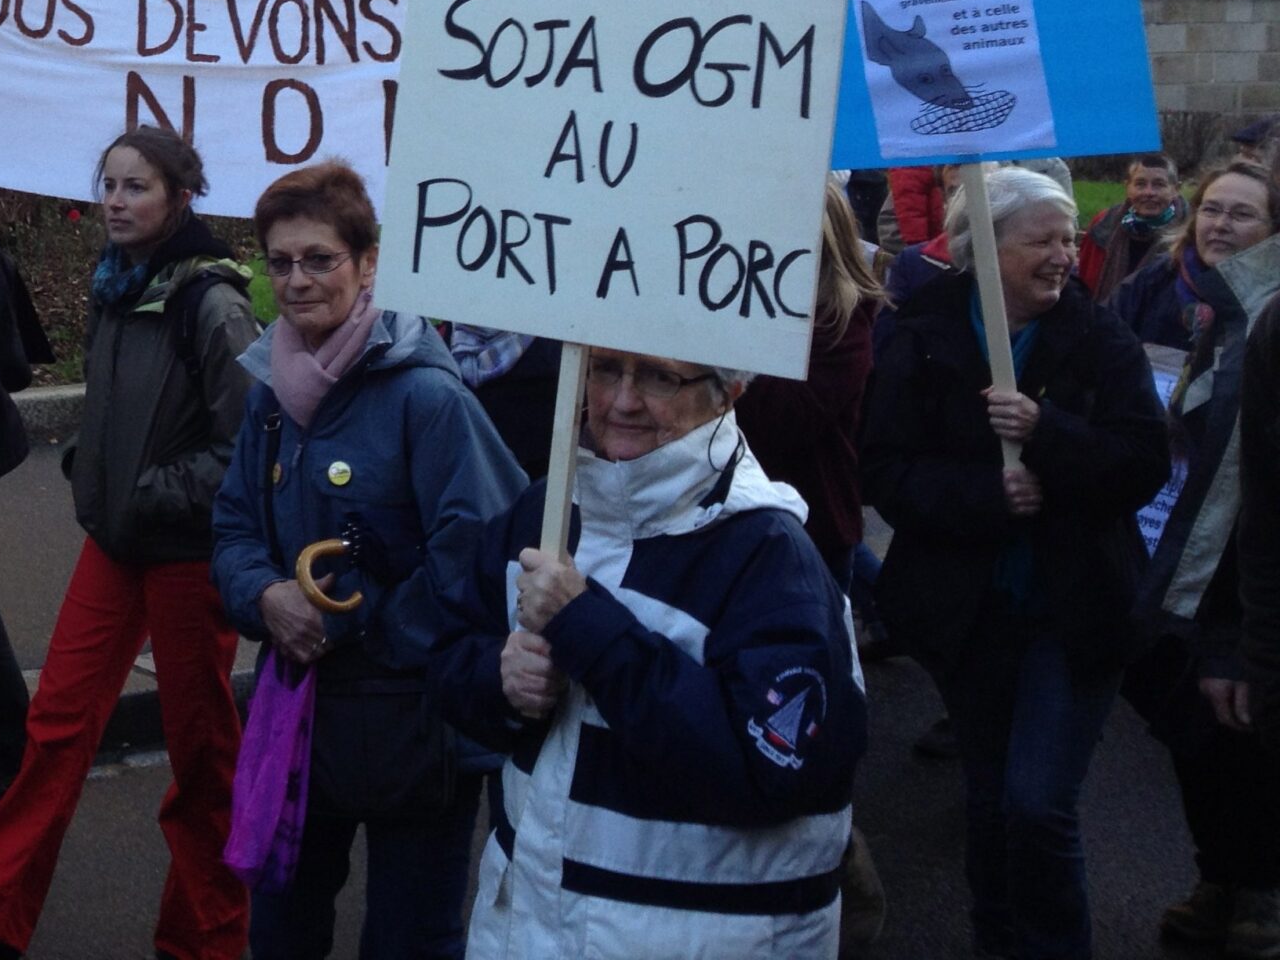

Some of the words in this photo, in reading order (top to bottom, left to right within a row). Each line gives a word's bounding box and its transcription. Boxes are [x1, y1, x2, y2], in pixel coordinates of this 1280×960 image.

[950, 24, 977, 35] des
[981, 19, 1029, 32] autres
[953, 9, 968, 20] et
[972, 7, 981, 18] à
[985, 3, 1020, 16] celle
[633, 14, 816, 119] OGM
[962, 36, 1025, 50] animaux
[544, 109, 638, 188] AU
[412, 178, 572, 296] PORT
[596, 227, 640, 300] A
[674, 214, 812, 319] PORC
